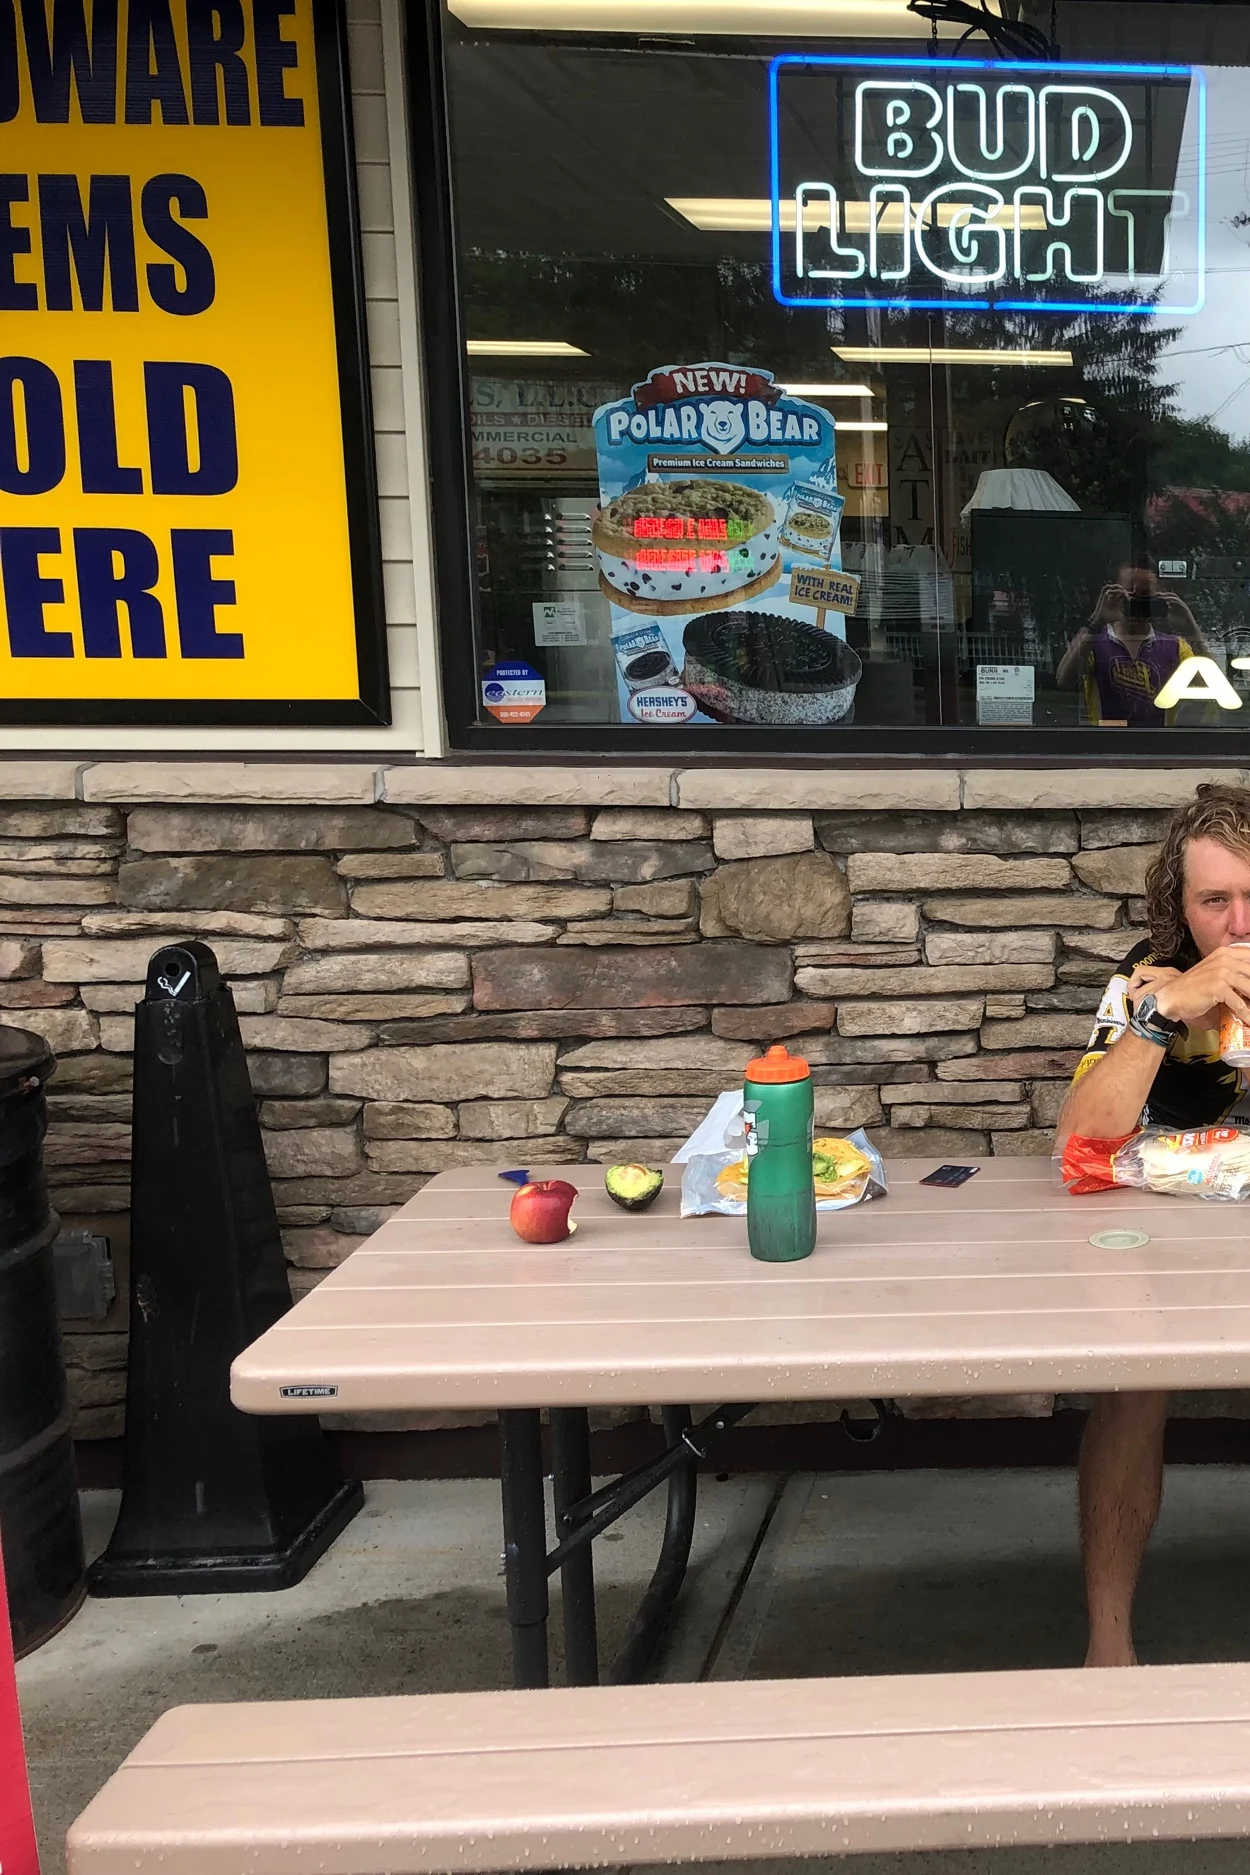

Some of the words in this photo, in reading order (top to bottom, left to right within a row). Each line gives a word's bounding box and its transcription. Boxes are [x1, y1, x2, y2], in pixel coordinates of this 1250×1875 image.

[855, 80, 1133, 181] BUD
[796, 181, 1190, 283] LIGHT
[0, 173, 216, 316] EMS
[671, 370, 747, 394] NEW!
[0, 356, 239, 496] OLD
[609, 404, 699, 441] POLAR
[747, 400, 819, 441] BEAR
[472, 446, 567, 465] 4035
[652, 457, 691, 468] Premium
[692, 458, 705, 467] Ice
[706, 458, 734, 468] Cream
[735, 458, 785, 468] Sandwiches
[854, 463, 884, 486] EXIT
[0, 527, 245, 660] ERE
[797, 573, 825, 589] WITH
[829, 580, 853, 595] REAL
[794, 585, 811, 598] ICE
[812, 589, 853, 607] CREAM!
[496, 669, 521, 677] PROTECTED
[486, 689, 543, 697] eastern
[636, 696, 689, 708] HERSHEY'S
[641, 709, 654, 718] Ice
[655, 709, 687, 718] Cream
[287, 1388, 331, 1396] LIFETIME
